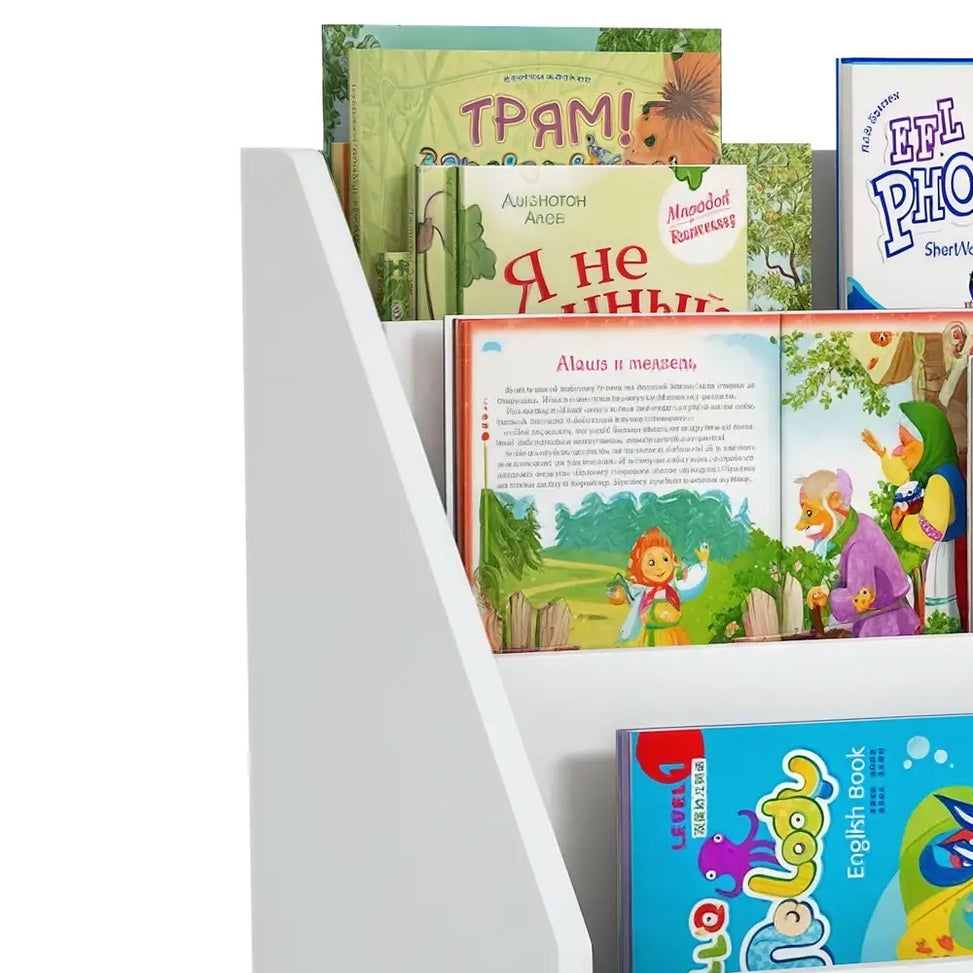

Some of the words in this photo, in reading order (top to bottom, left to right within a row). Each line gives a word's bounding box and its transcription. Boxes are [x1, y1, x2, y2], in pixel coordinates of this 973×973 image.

[460, 89, 636, 150] ТРЯМ!
[888, 97, 966, 166] EFL
[503, 248, 557, 313] Я
[571, 245, 648, 288] не
[845, 745, 866, 799] Book
